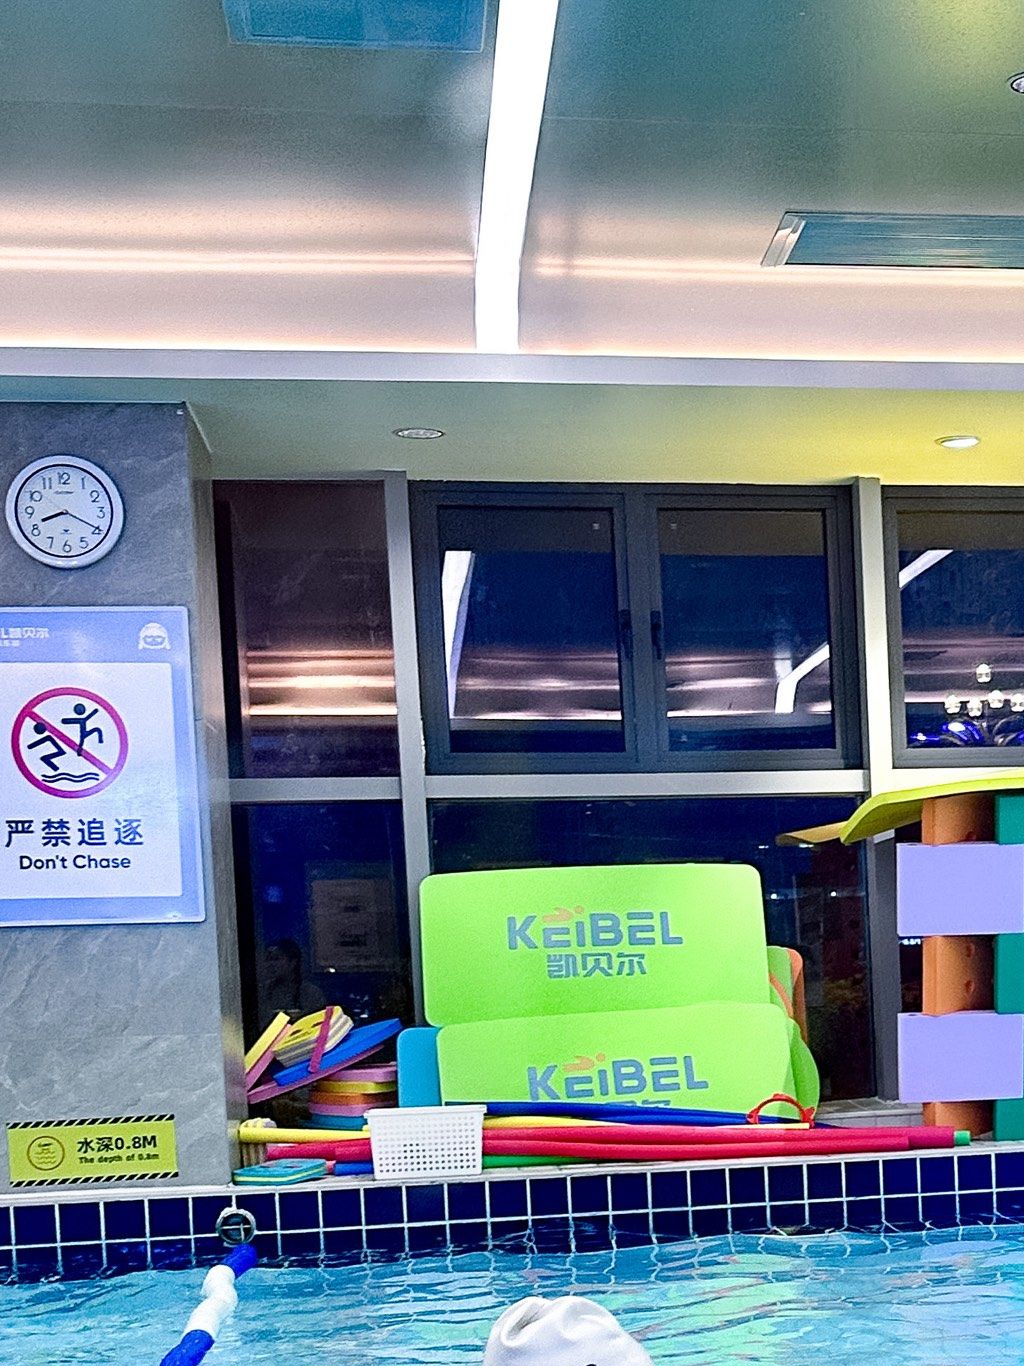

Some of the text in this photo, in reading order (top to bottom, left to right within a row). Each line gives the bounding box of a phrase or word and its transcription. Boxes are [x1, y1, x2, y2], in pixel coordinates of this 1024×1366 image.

[41, 476, 52, 490] 11
[57, 472, 70, 485] 12
[90, 490, 100, 503] 2
[25, 506, 35, 519] 9
[96, 507, 105, 519] 3
[31, 524, 41, 537] 8
[91, 525, 104, 535] 4
[46, 536, 54, 549] 7
[62, 540, 72, 553] 6
[79, 537, 89, 549] 5
[5, 818, 144, 848] 严禁追逐
[19, 854, 132, 870] Don't Chase
[507, 907, 683, 950] KEIBEL
[547, 953, 647, 979] 凯贝尔
[527, 1054, 709, 1101] KEIBEL
[77, 1135, 157, 1154] 水深0.8M
[79, 1156, 95, 1164] The
